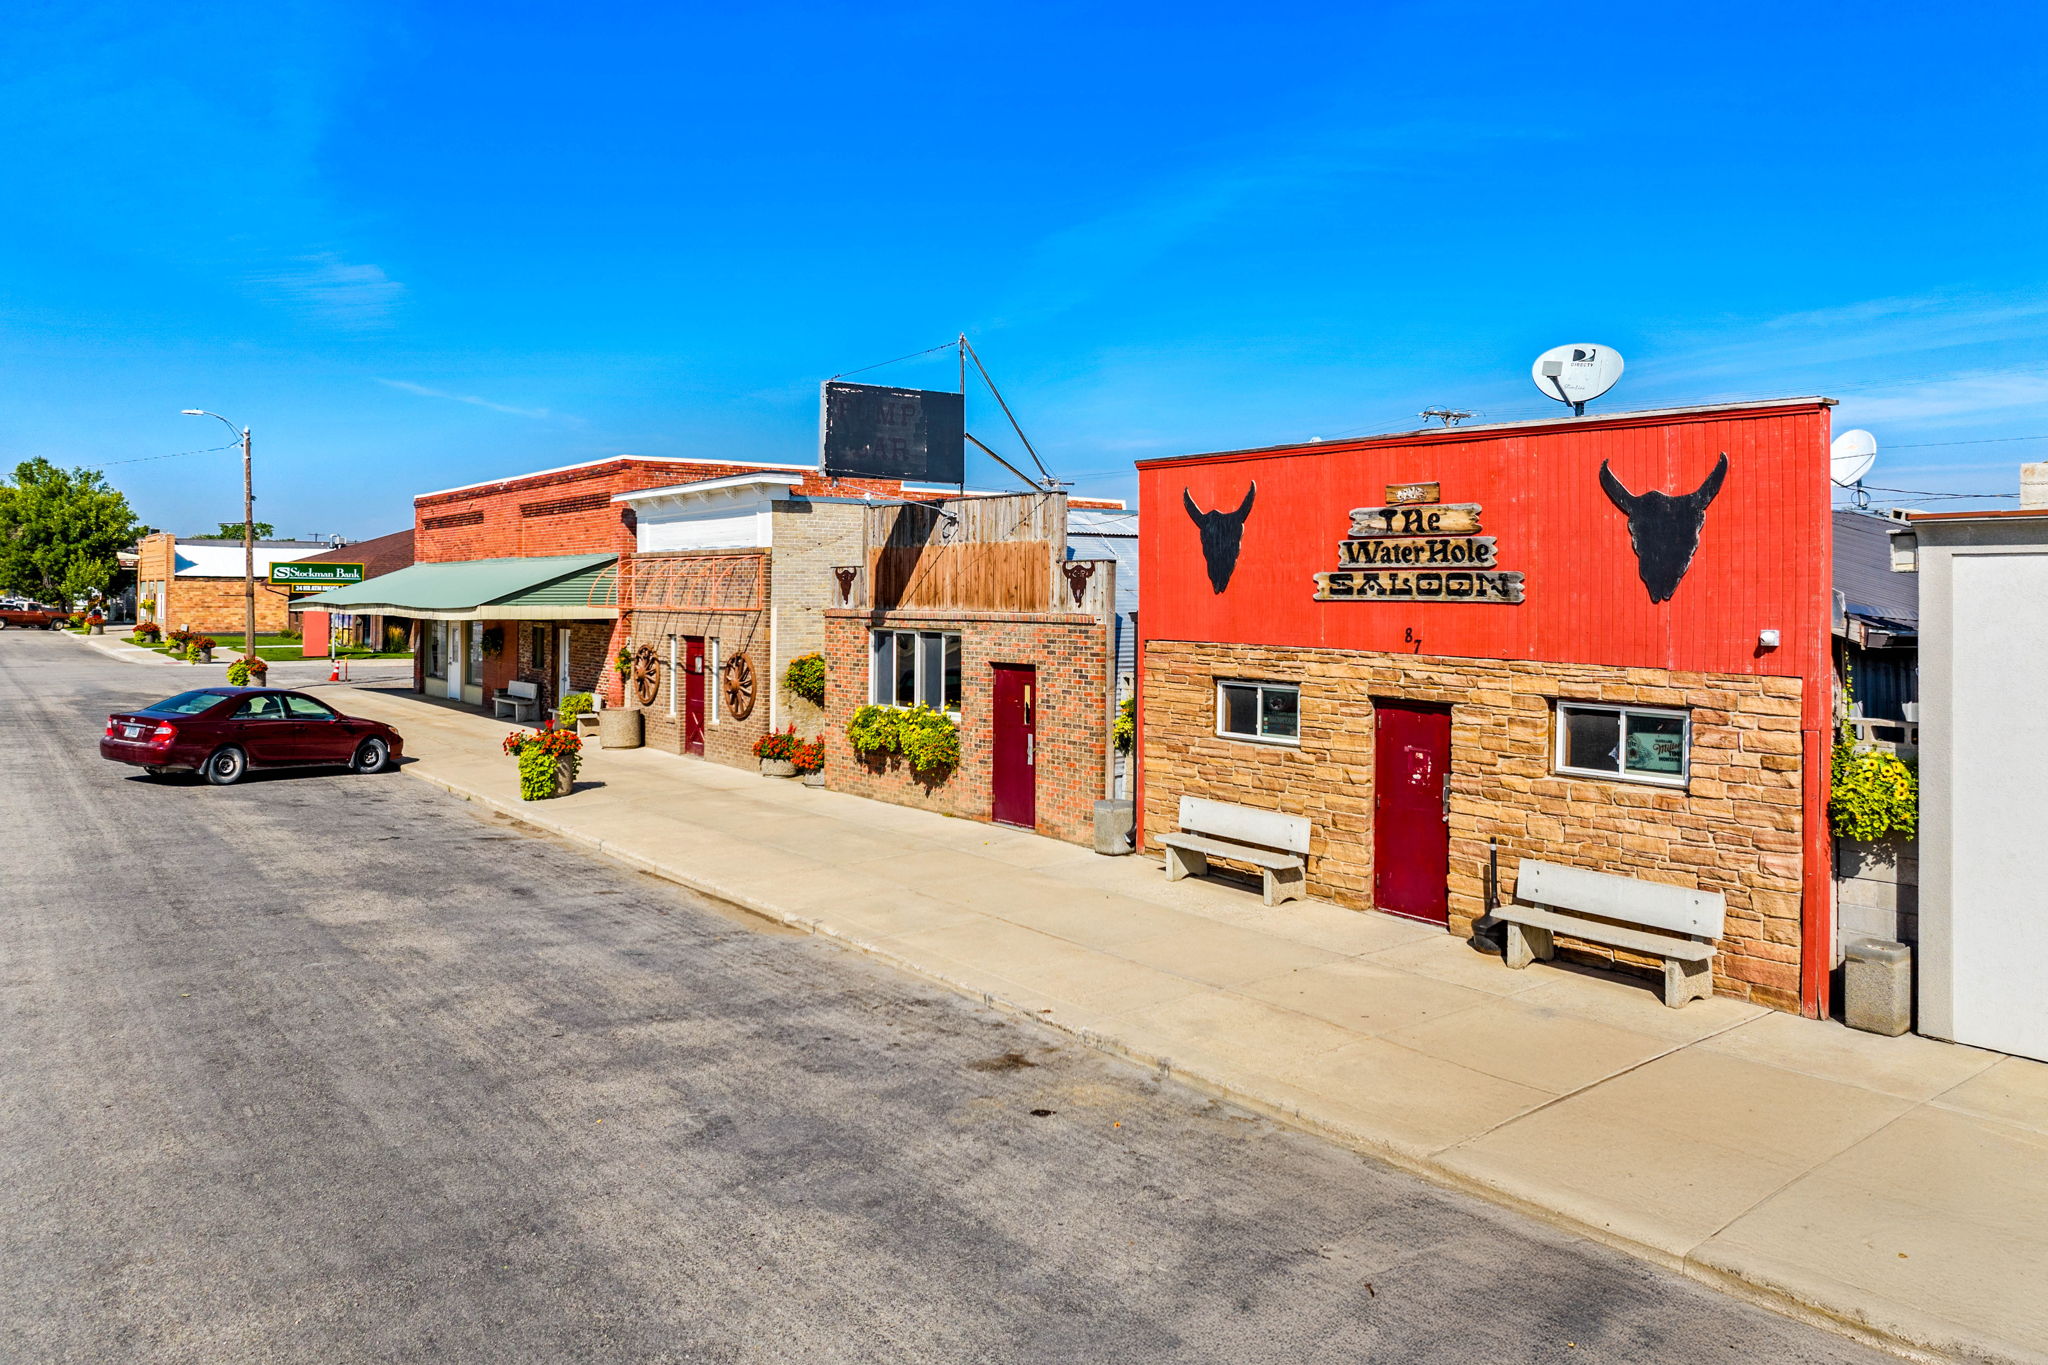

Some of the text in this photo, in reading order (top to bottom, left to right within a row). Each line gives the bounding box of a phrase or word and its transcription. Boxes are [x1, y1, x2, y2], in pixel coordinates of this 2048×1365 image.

[290, 567, 333, 578] Stockman
[336, 567, 360, 578] Bank
[1328, 572, 1510, 598] SALOON
